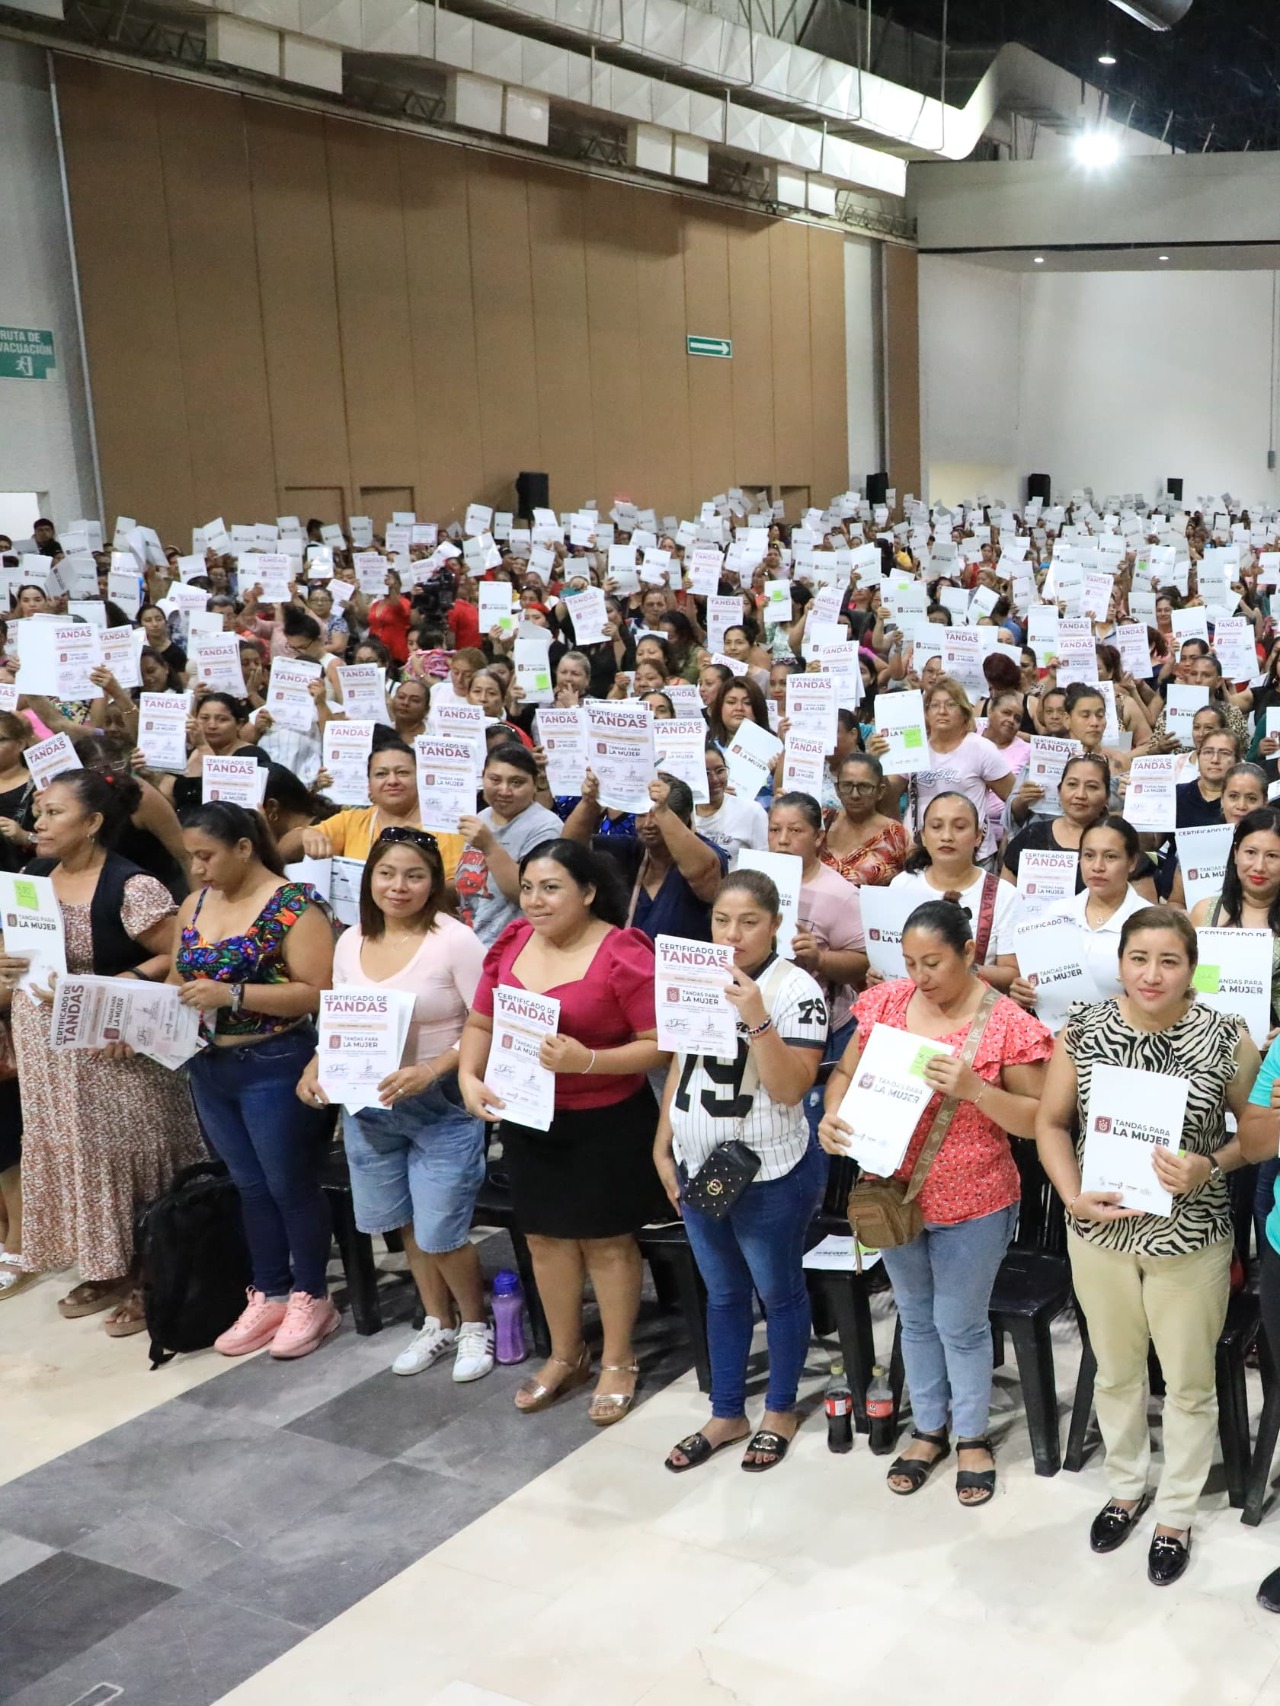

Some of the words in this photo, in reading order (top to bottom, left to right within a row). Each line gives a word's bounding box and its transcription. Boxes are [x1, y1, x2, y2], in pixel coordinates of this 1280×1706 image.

[0, 330, 25, 341] RUTA
[28, 332, 40, 342] DE
[56, 630, 92, 640] TANDAS
[946, 634, 978, 642] TANDAS
[199, 648, 234, 656] TANDAS
[822, 646, 853, 654] TANDAS
[340, 669, 376, 678] TANDAS
[790, 681, 831, 689] TANDAS
[144, 700, 186, 710] TANDAS
[437, 710, 480, 720] TANDAS
[539, 716, 578, 724] TANDAS
[588, 715, 647, 728] TANDAS
[329, 728, 370, 736] TANDAS
[654, 726, 702, 734] TANDAS
[28, 740, 66, 763] TANDAS
[419, 746, 471, 759] TANDAS
[789, 742, 823, 754] TANDAS
[207, 764, 254, 780] TANDAS
[1134, 762, 1172, 770] TANDAS
[1026, 857, 1074, 868] TANDAS
[31, 922, 56, 931] MUJER
[1018, 918, 1062, 935] CERTIFICADO
[659, 943, 714, 955] CERTIFICADO
[660, 950, 728, 968] TANDAS
[1039, 967, 1061, 976] TANDAS
[1063, 963, 1080, 972] PARA
[1040, 976, 1052, 985] LA
[1054, 969, 1082, 982] MUJER
[1229, 986, 1263, 994] MUJER
[325, 1001, 388, 1012] TANDAS
[498, 992, 545, 1012] CERTIFICADO
[693, 997, 719, 1005] MUJER
[116, 998, 124, 1018] MUJER
[498, 1000, 554, 1026] TANDAS
[798, 998, 827, 1026] 79
[63, 985, 84, 1045] TANDAS
[888, 1088, 920, 1104] MUJER
[1116, 1119, 1148, 1132] TANDAS
[1150, 1127, 1170, 1137] PARA
[1113, 1126, 1127, 1137] LA
[1131, 1130, 1170, 1147] MUJER
